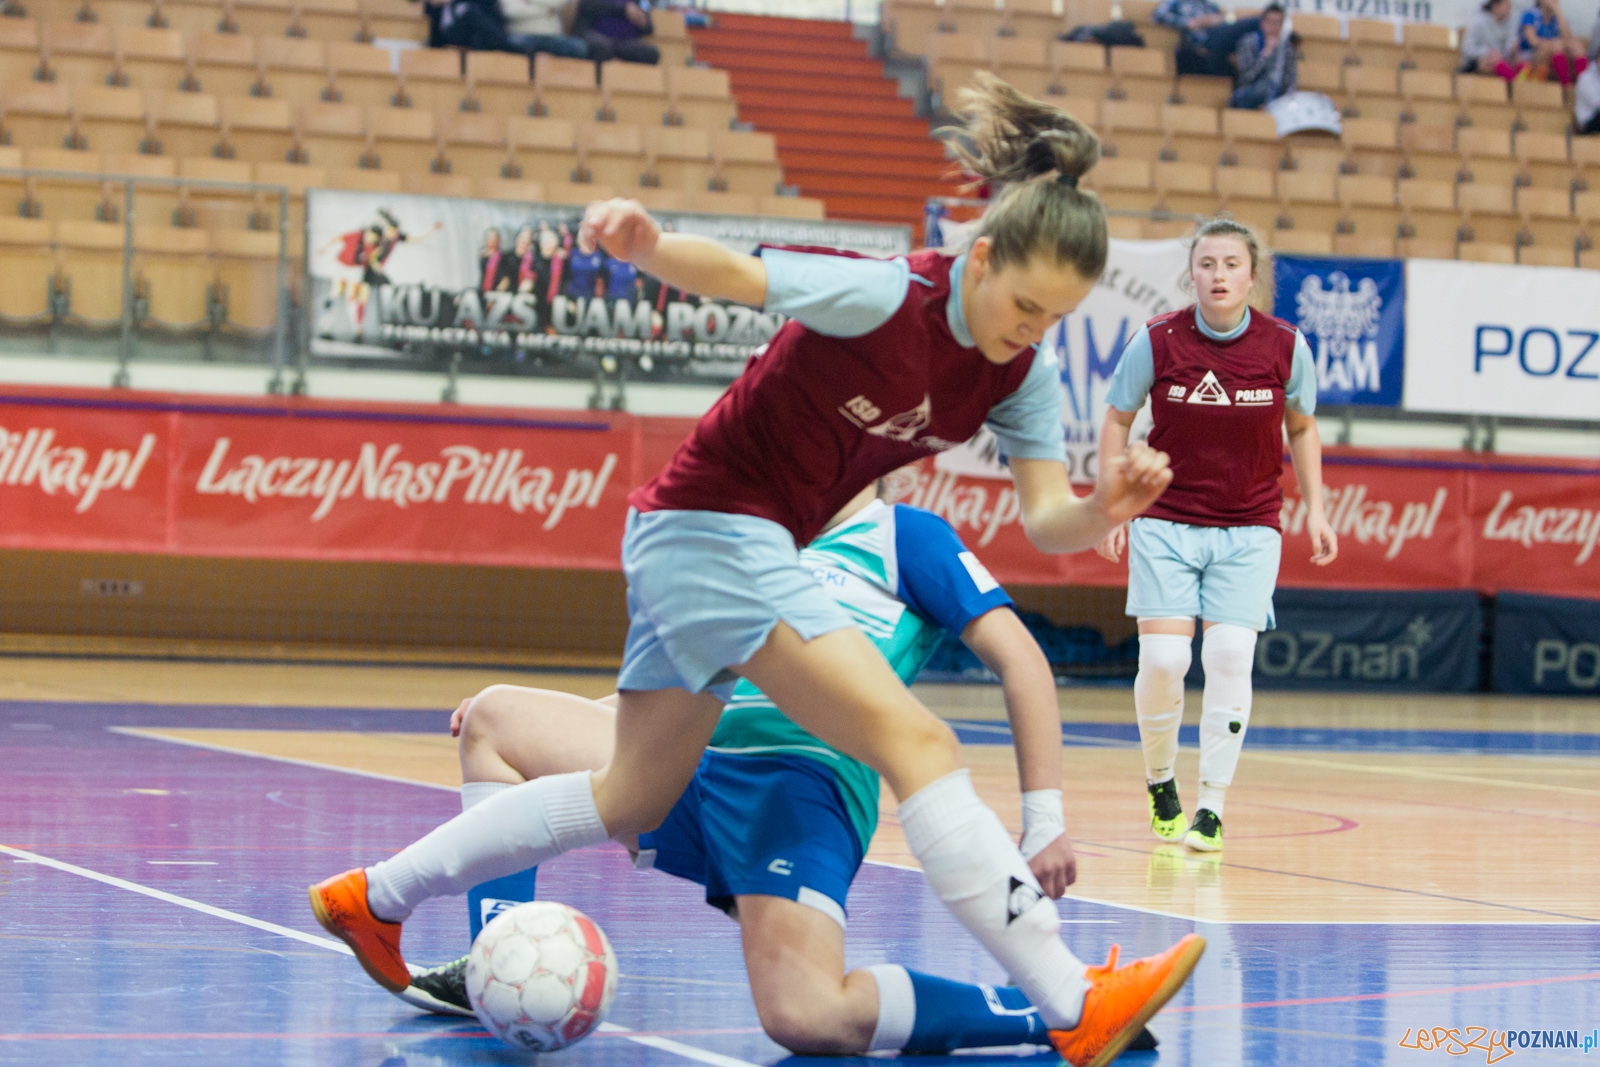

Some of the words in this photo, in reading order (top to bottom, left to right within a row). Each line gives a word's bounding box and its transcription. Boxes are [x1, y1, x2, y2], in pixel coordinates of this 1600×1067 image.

[379, 282, 442, 325] KU
[452, 288, 538, 331] AZS
[552, 296, 651, 340] UAM
[844, 394, 882, 423] ISO
[1167, 385, 1187, 398] ISO
[1235, 388, 1274, 402] POLSKA
[0, 425, 157, 514] ilka.pl
